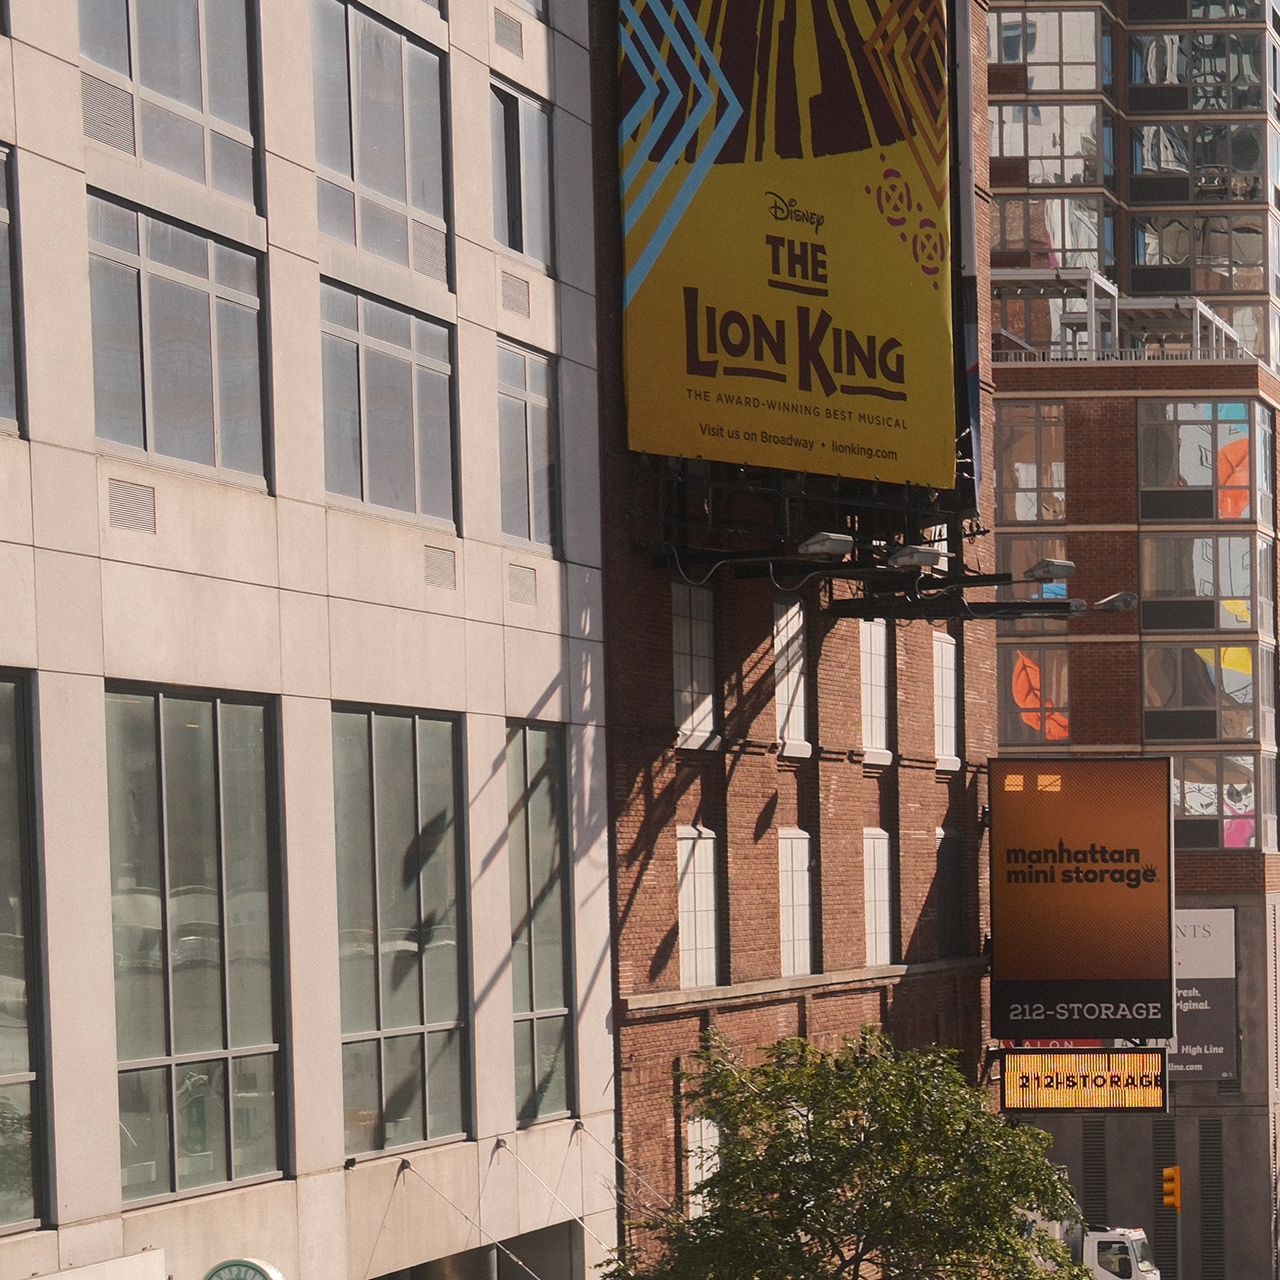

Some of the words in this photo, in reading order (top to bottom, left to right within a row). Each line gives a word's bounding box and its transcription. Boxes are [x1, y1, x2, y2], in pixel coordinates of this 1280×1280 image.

[765, 234, 828, 284] THE
[686, 388, 711, 403] THE
[716, 392, 821, 419] AWARD-WINNING
[825, 406, 854, 423] BEST
[858, 410, 909, 431] MUSICAL
[699, 423, 725, 440] Visit
[728, 427, 742, 441] us
[743, 429, 758, 443] on
[761, 430, 815, 452] Broadway
[832, 440, 898, 461] lionking.com
[1007, 838, 1140, 864] manhattan
[1007, 865, 1056, 884] mini
[1061, 862, 1158, 889] storage
[1010, 1003, 1162, 1020] 212-STORAGE
[1181, 1045, 1203, 1056] High
[1204, 1045, 1224, 1055] Line
[1019, 1074, 1162, 1090] 212-STORAGE
